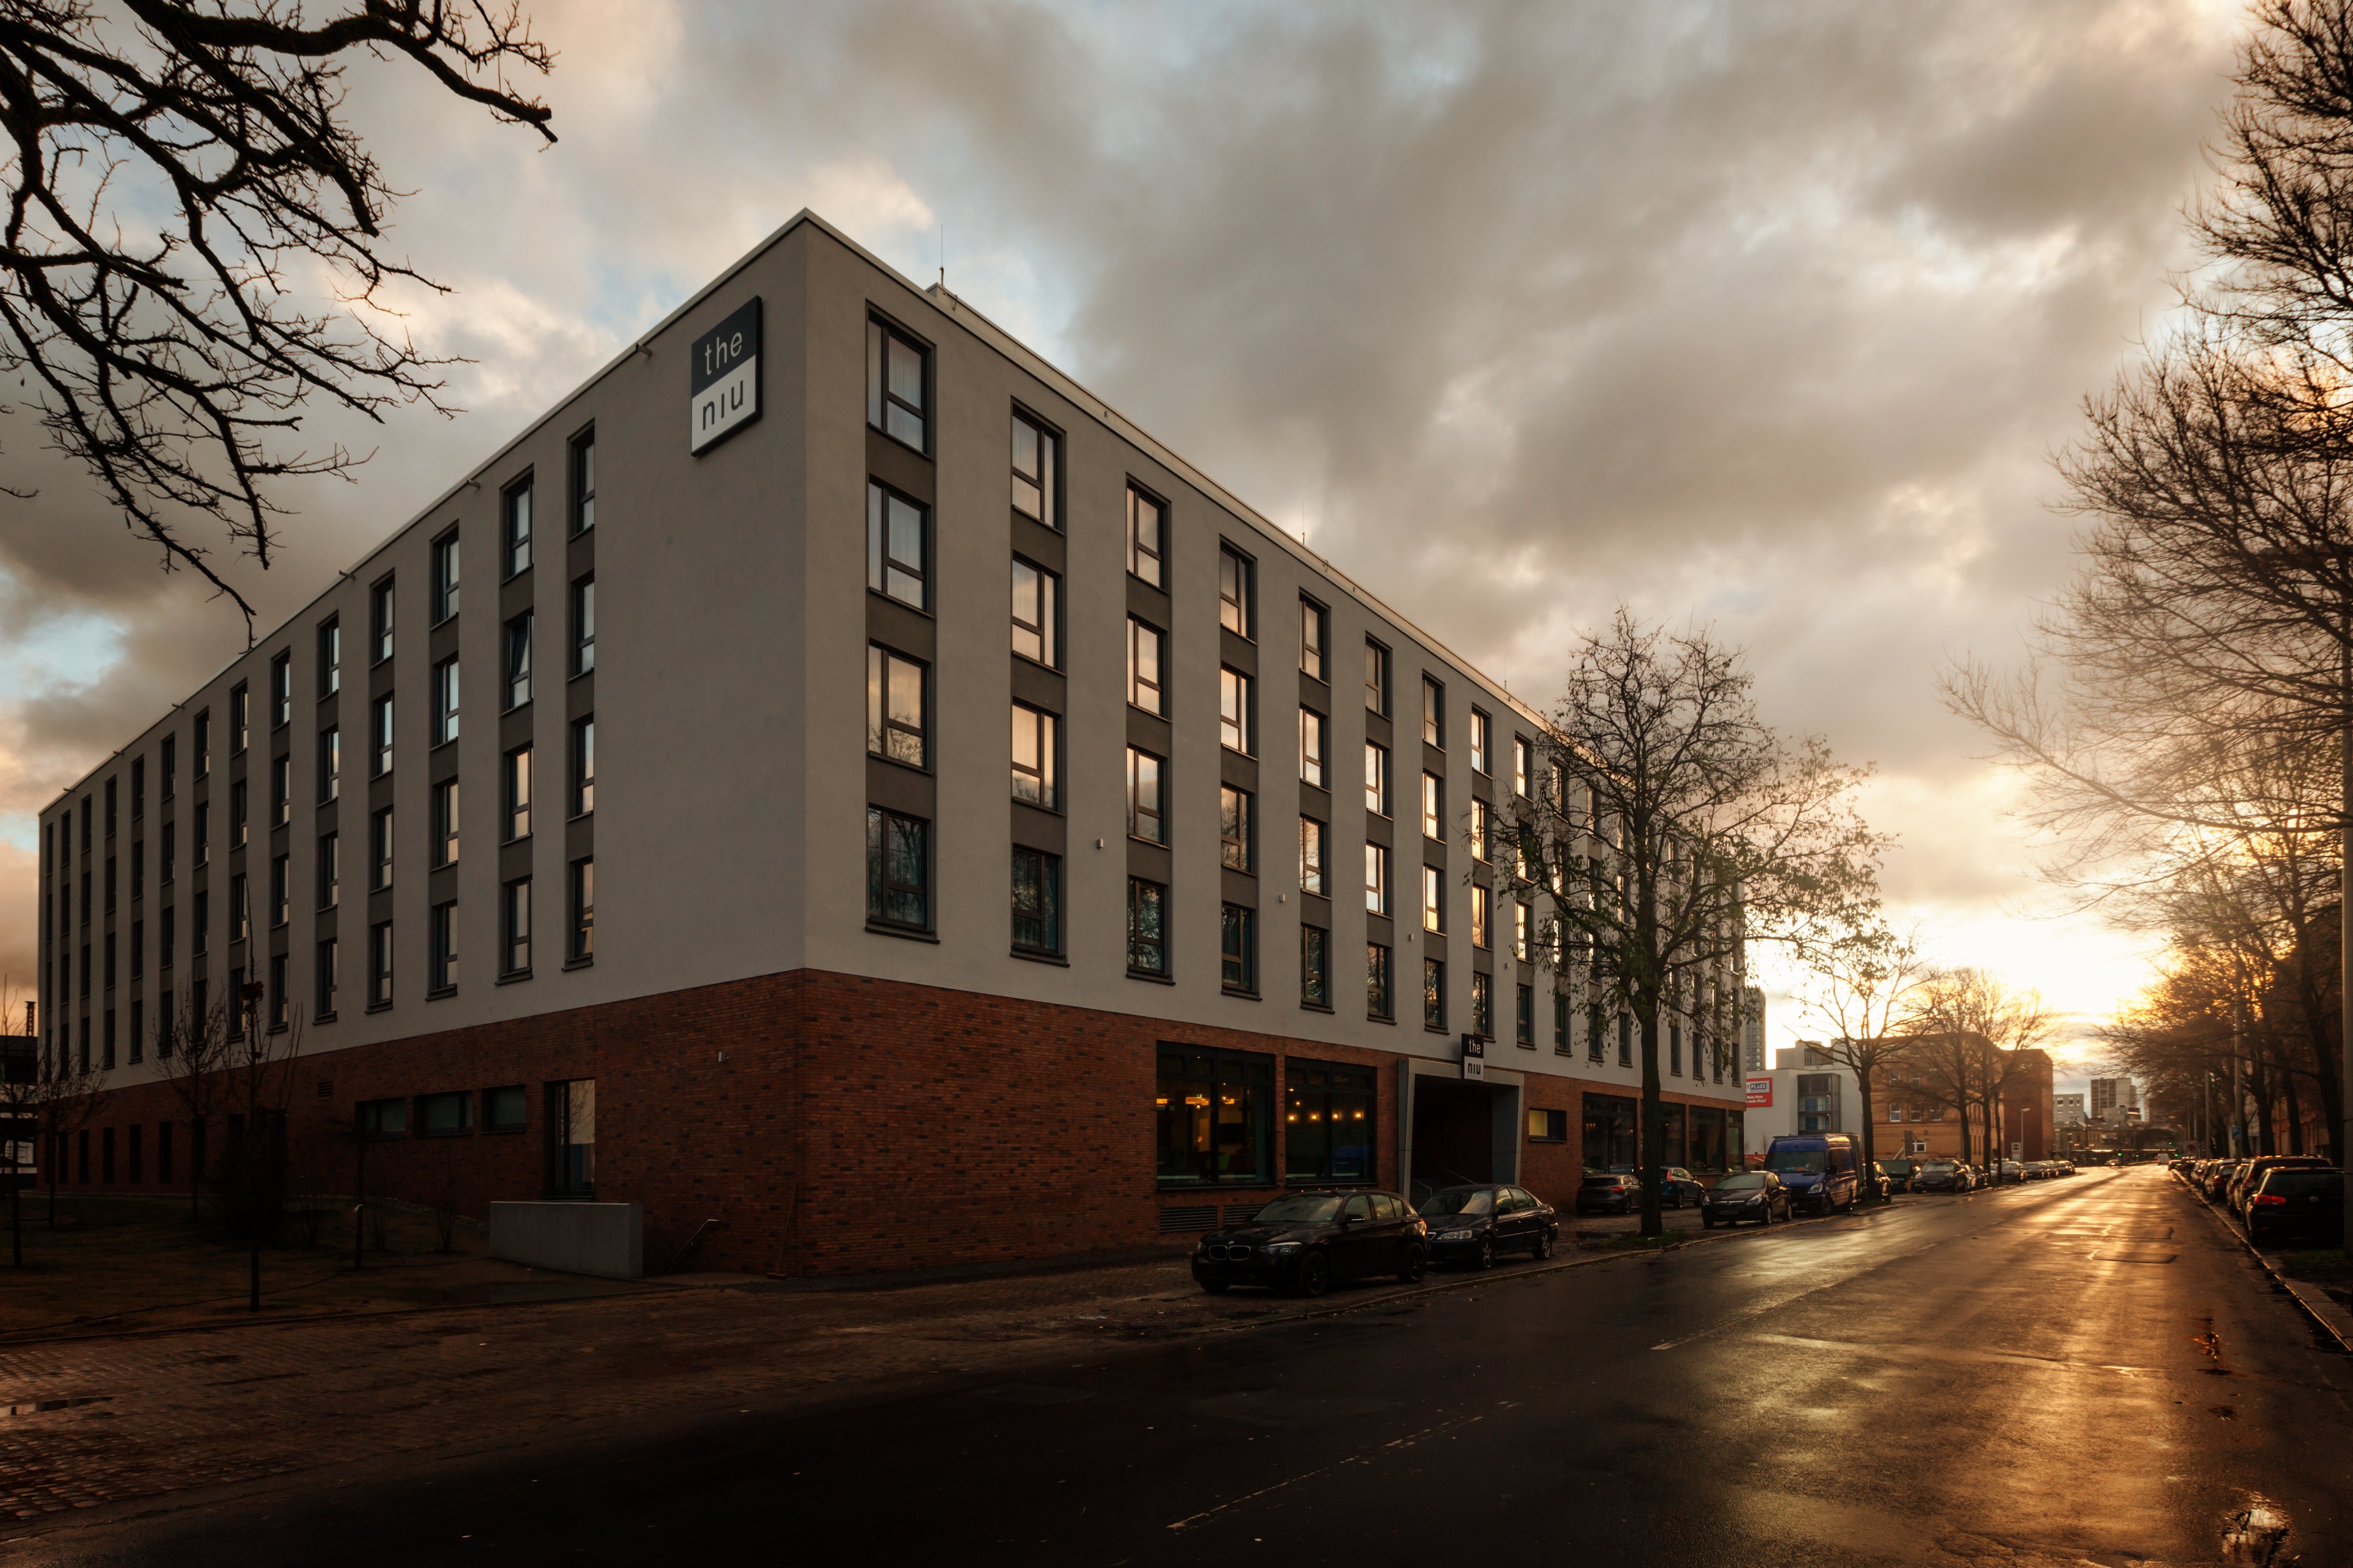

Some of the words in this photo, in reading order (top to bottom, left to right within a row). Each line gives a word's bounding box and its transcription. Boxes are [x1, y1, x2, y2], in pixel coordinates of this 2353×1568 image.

[705, 332, 742, 376] the
[702, 380, 743, 431] niu
[1469, 1039, 1480, 1054] the
[1468, 1063, 1480, 1074] niu
